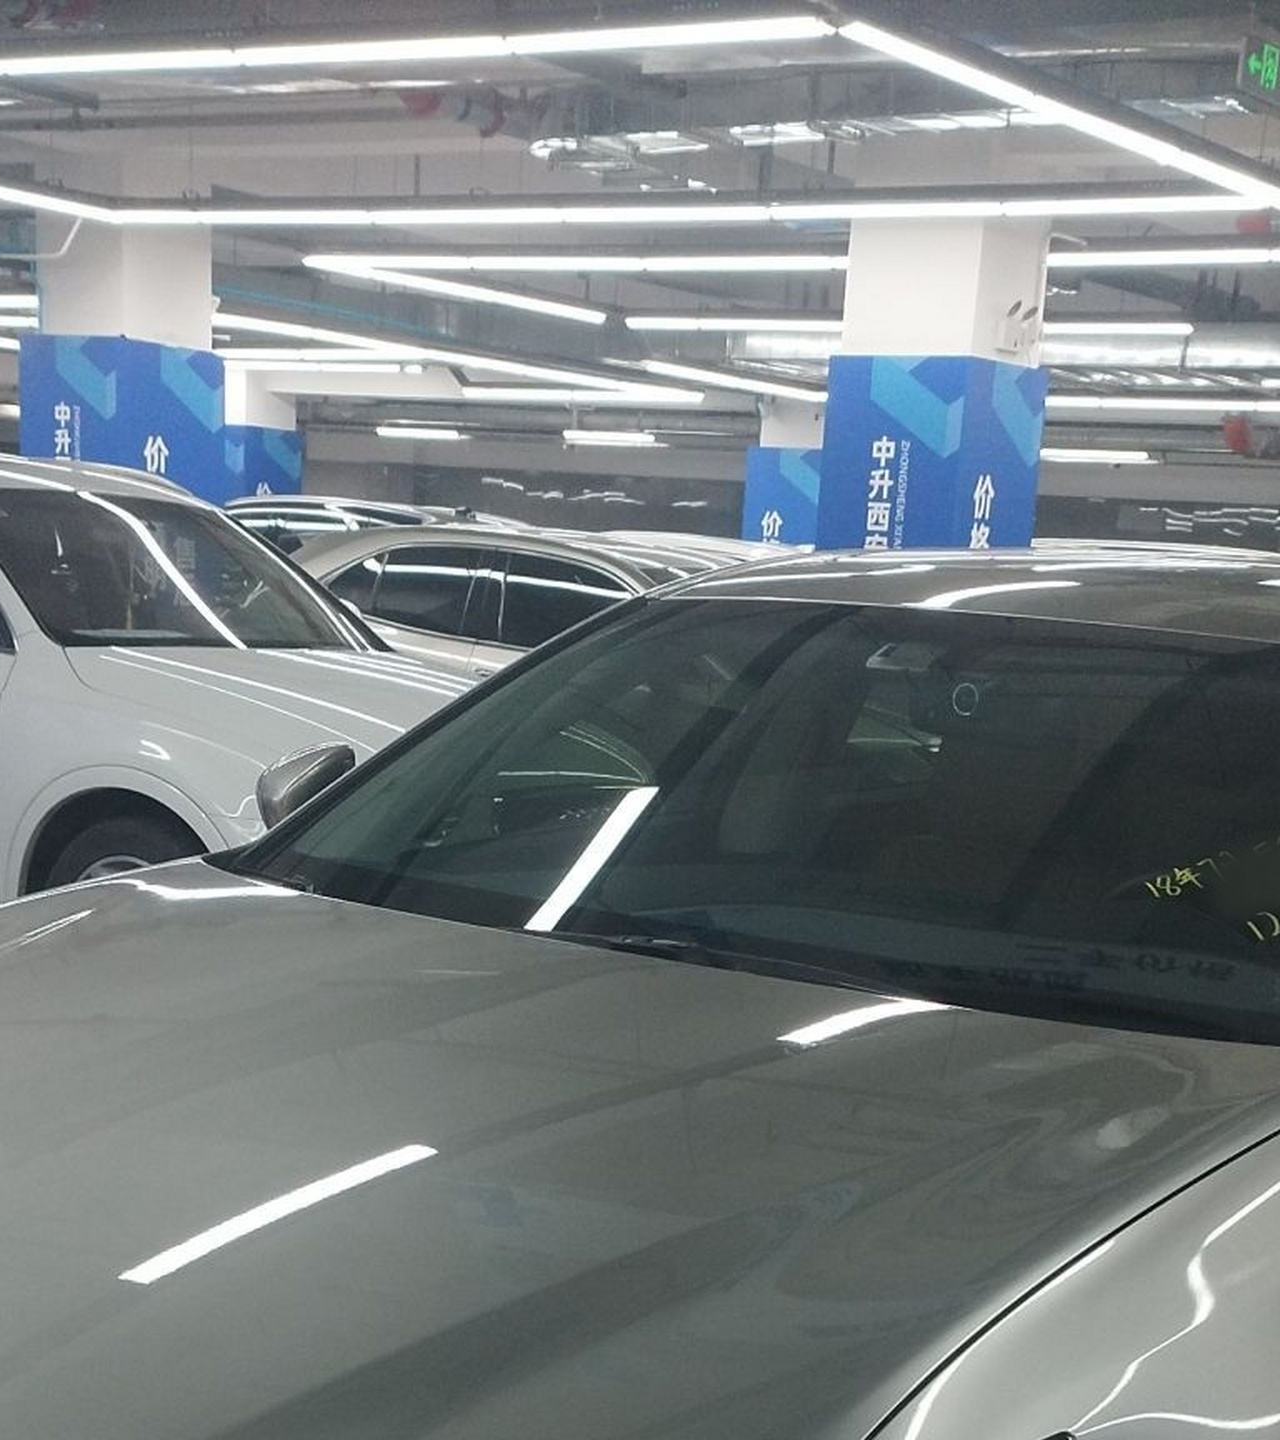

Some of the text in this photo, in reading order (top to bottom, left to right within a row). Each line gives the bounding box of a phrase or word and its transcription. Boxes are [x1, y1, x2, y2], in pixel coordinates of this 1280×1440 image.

[54, 401, 71, 459] 中升
[144, 435, 169, 474] 价
[895, 439, 911, 521] ZHONGSHENG
